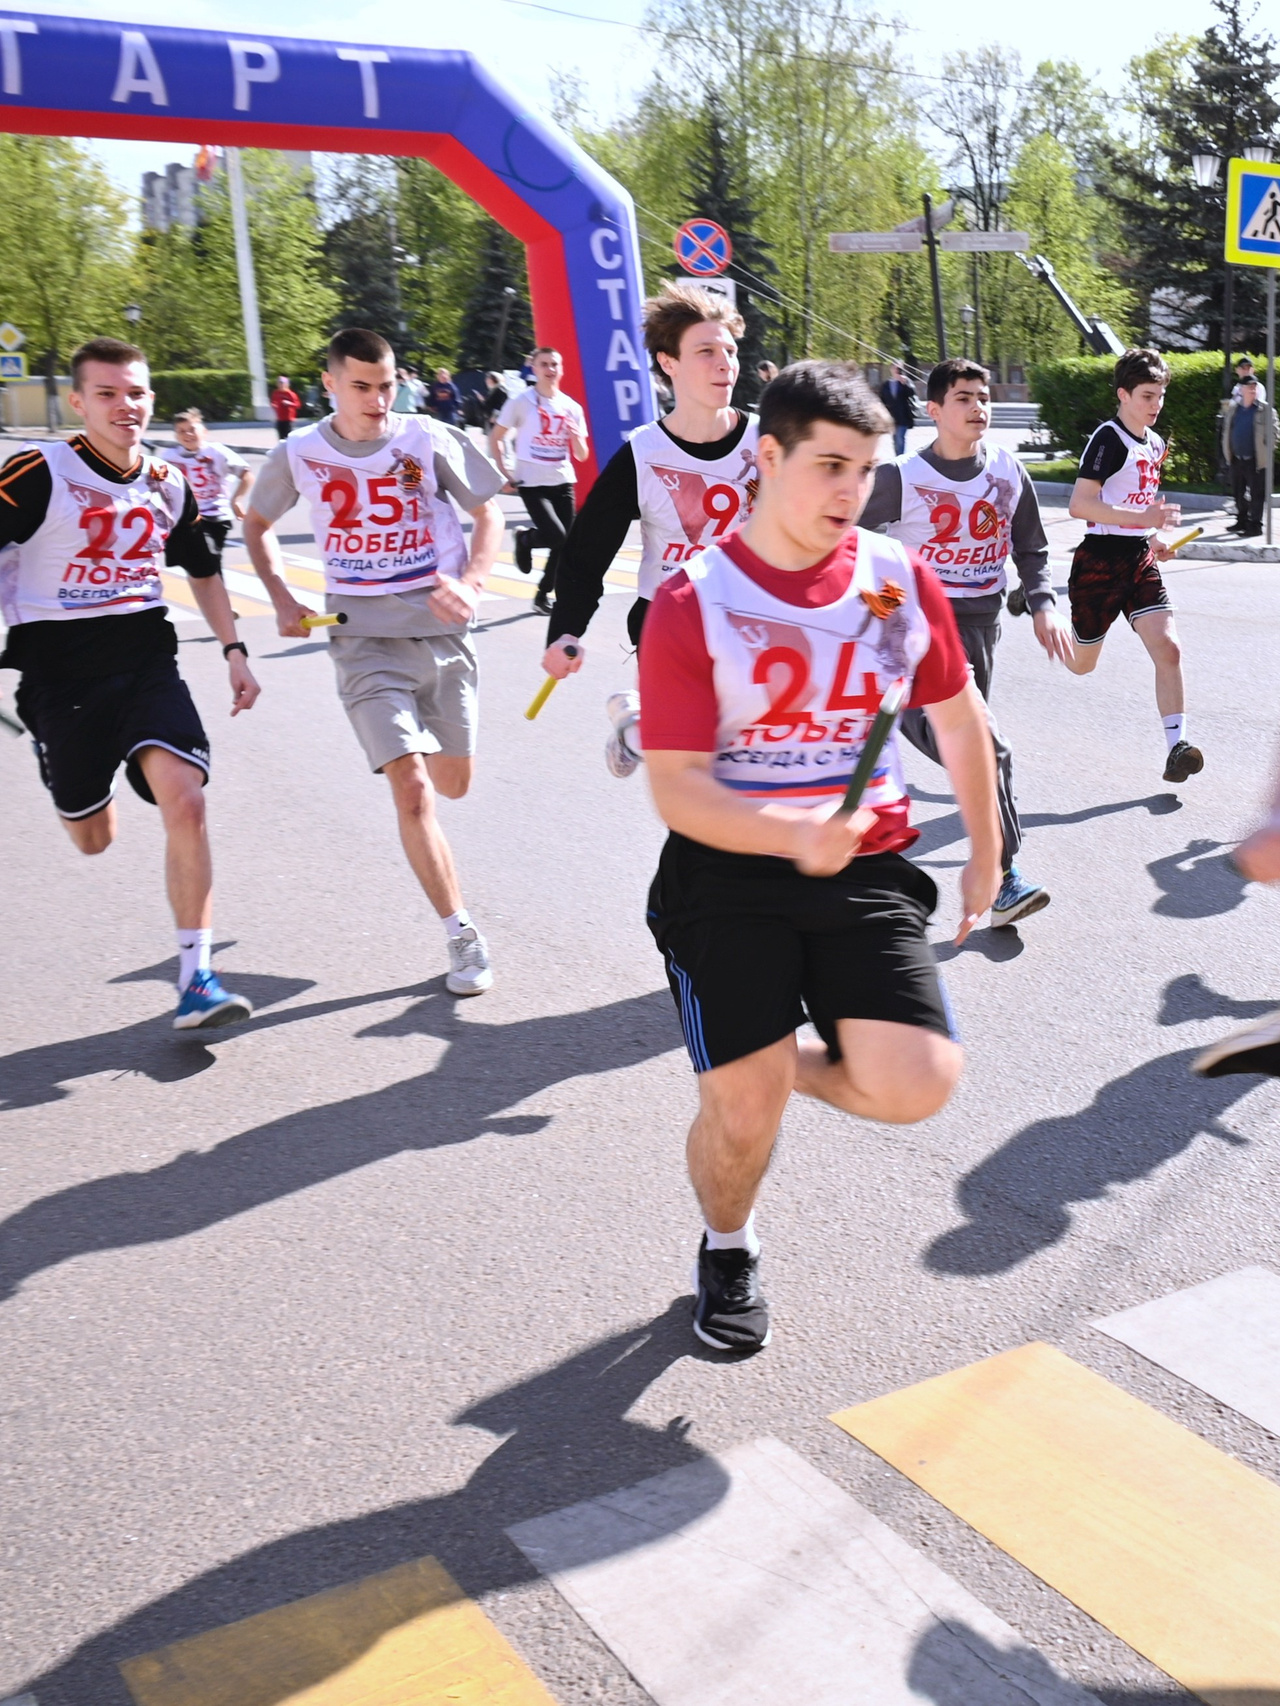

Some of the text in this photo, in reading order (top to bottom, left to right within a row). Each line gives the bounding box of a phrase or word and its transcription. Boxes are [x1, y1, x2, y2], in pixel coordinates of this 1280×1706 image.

[590, 227, 641, 442] СТАР
[75, 506, 154, 560] 22
[702, 483, 740, 538] 9
[928, 499, 999, 544] 20
[324, 526, 434, 555] ПОБЕДА
[377, 557, 389, 568] С
[918, 540, 1009, 565] ПОБЕДА
[752, 641, 888, 726] 24
